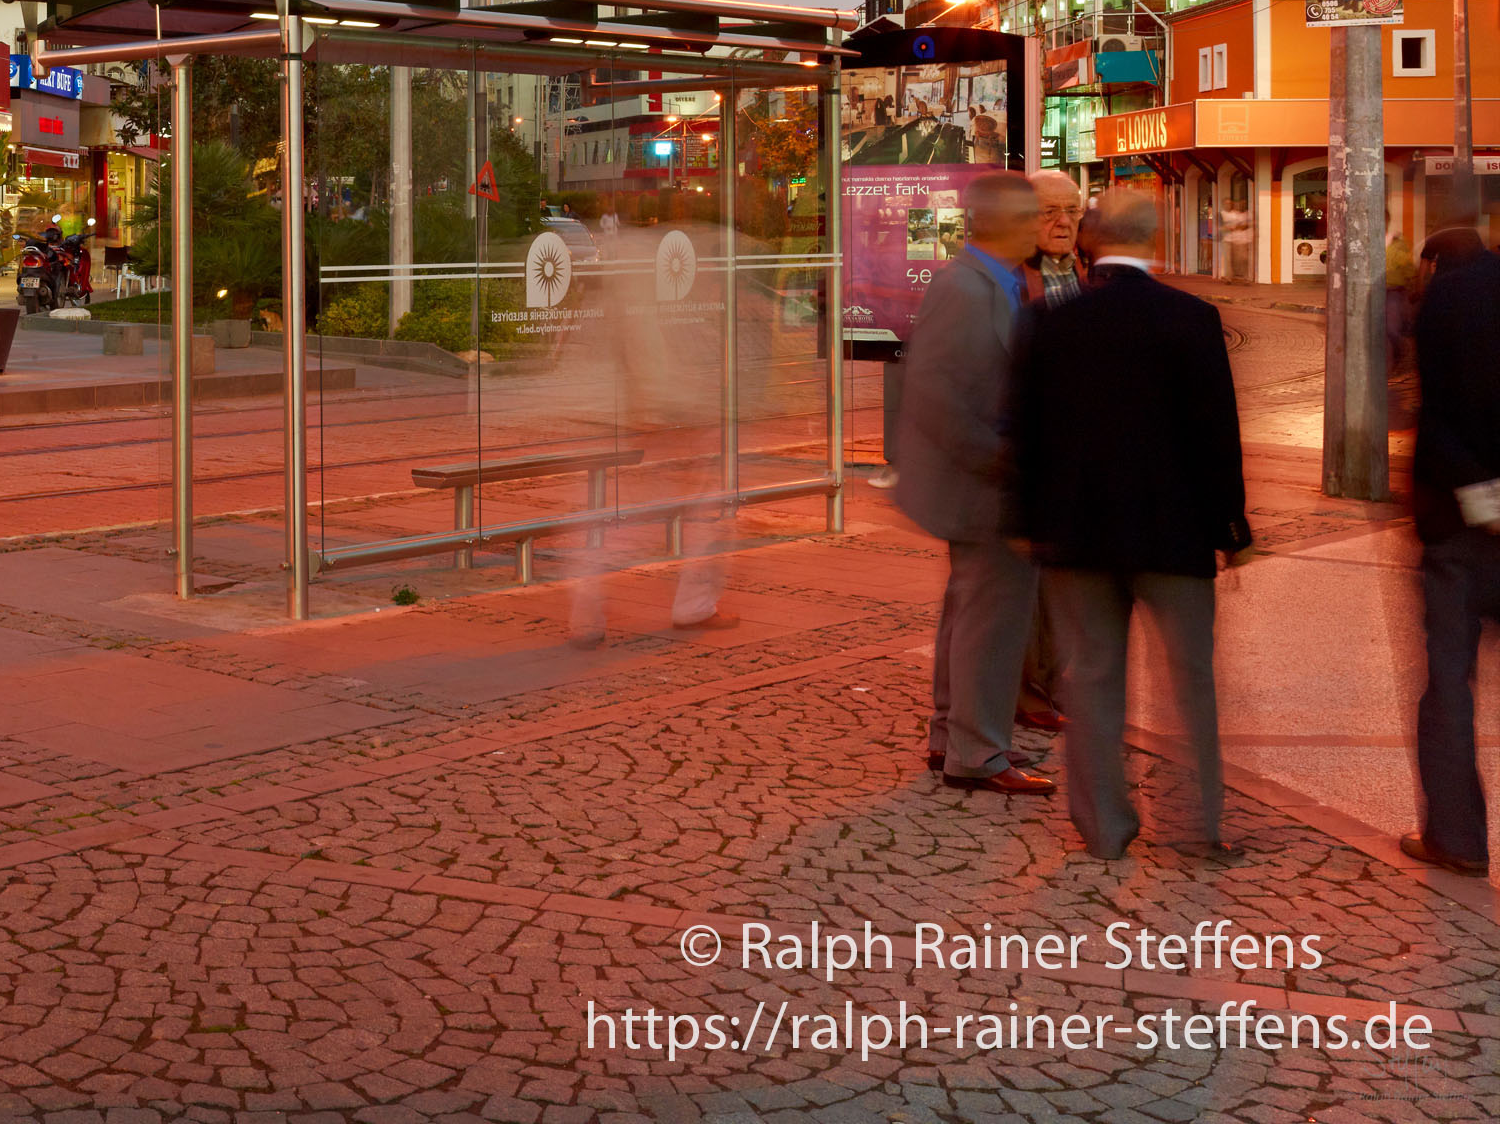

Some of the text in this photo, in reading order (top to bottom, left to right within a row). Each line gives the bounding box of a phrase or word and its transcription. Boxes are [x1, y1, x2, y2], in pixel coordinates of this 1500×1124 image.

[56, 69, 72, 92] BÜFE
[1128, 111, 1167, 151] LOOXIS
[896, 182, 930, 196] farkı
